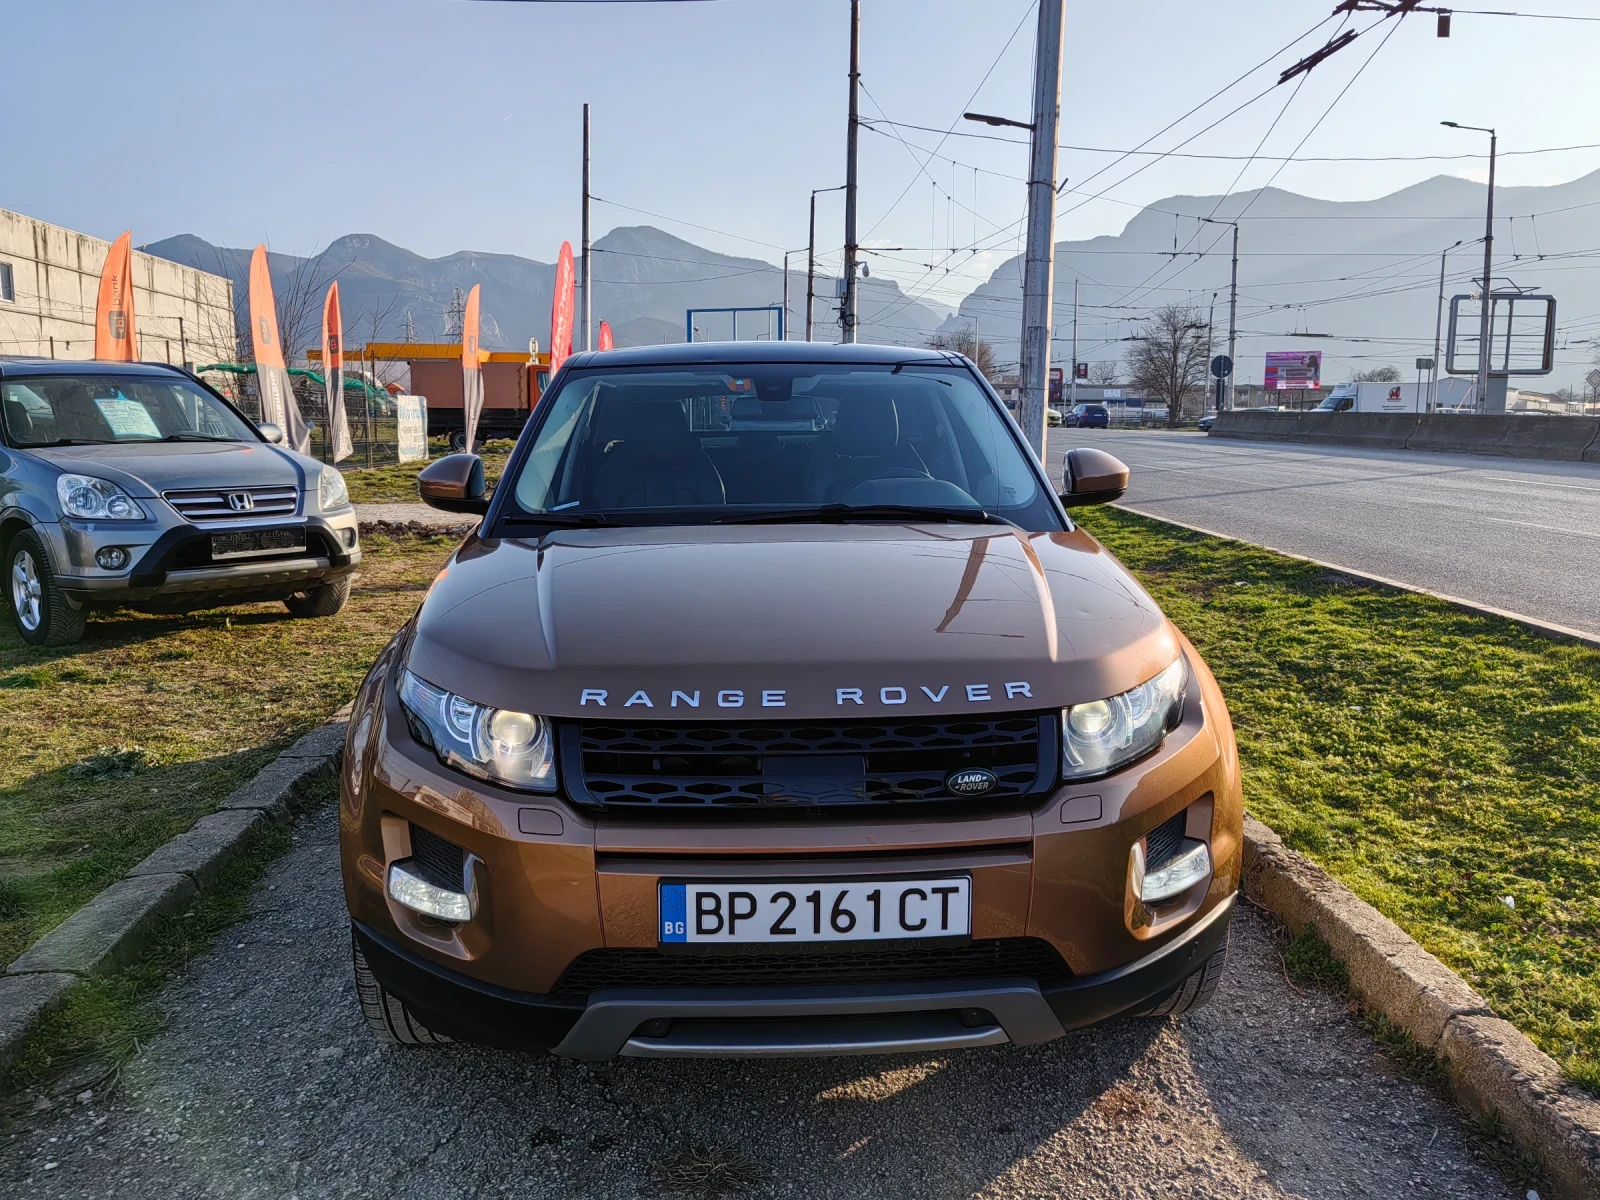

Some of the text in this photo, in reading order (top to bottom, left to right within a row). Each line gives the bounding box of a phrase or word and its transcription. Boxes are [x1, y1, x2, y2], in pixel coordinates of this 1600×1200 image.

[111, 274, 122, 306] bank
[580, 681, 1034, 707] RANGE ROVER
[957, 774, 982, 784] LAND
[959, 781, 990, 791] ROVER
[695, 886, 959, 935] BP 2161 CT
[664, 921, 684, 935] BG
